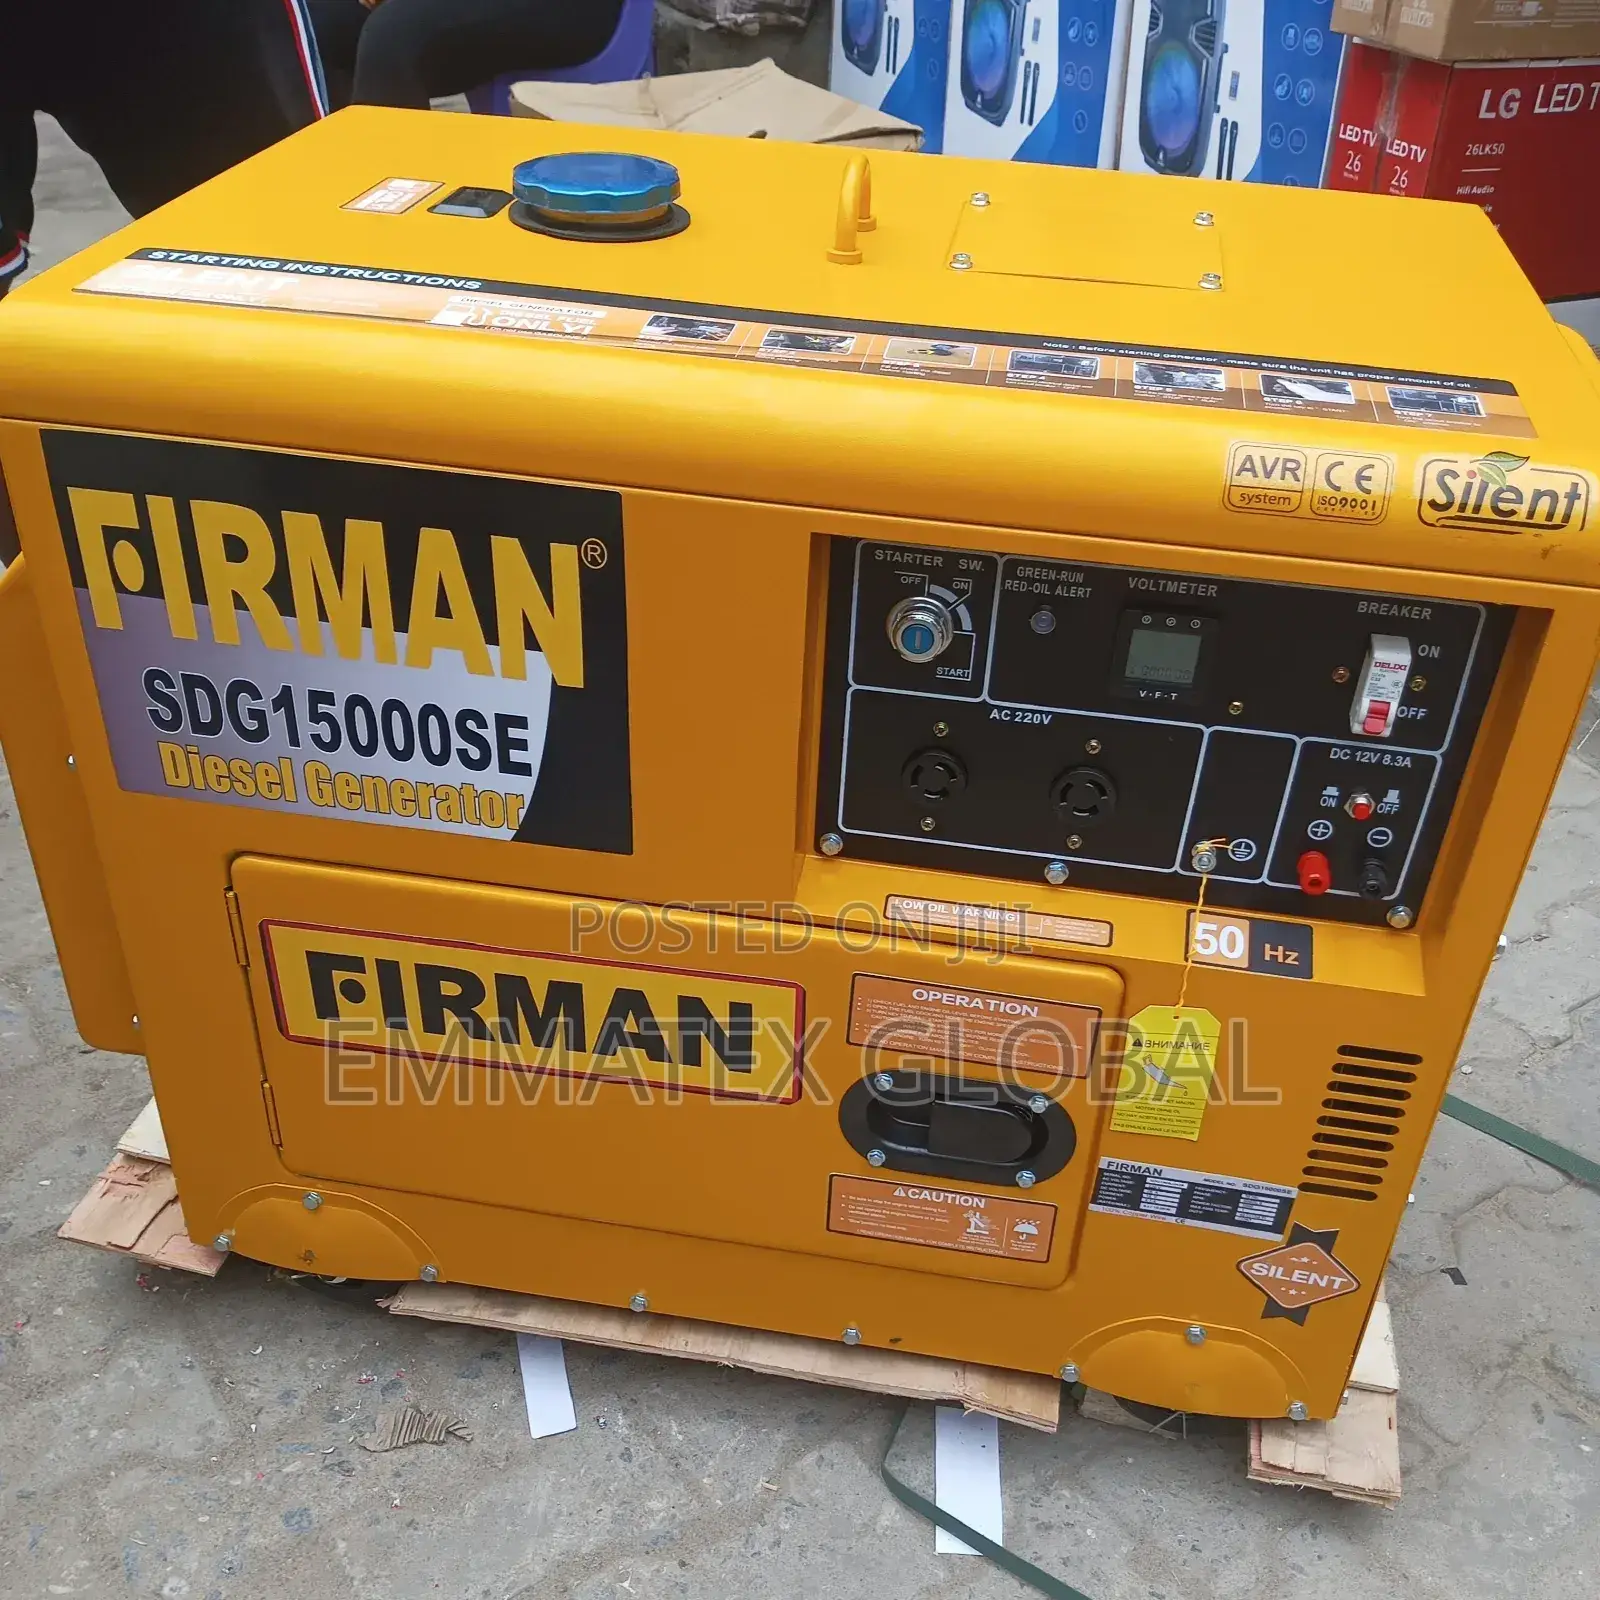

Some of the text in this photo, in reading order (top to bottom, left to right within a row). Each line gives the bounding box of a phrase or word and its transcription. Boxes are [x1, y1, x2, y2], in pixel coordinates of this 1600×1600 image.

[1479, 89, 1521, 119] LG
[1534, 84, 1584, 114] LED
[1339, 123, 1378, 147] LED TV
[1386, 138, 1426, 163] LED TV
[1466, 143, 1504, 156] 26LK50
[1345, 151, 1361, 172] 26
[1391, 166, 1408, 188] 26
[1456, 185, 1494, 195] Hifi Audio
[148, 251, 483, 290] STARTING INSTRUCTIONS
[510, 303, 594, 316] GENERATOR
[494, 316, 597, 336] ONLY!
[1078, 345, 1116, 353] Before
[1119, 349, 1160, 358] starting
[1358, 373, 1395, 381] proper
[1398, 377, 1440, 385] amount
[1393, 410, 1424, 418] STEP
[1235, 454, 1301, 482] AVR
[1324, 460, 1375, 495] CE
[1239, 491, 1291, 506] system
[1318, 496, 1376, 512] ISO9001
[1427, 467, 1582, 524] Silent
[875, 550, 984, 572] STARTER SW.
[901, 576, 921, 585] OFF
[1017, 567, 1084, 583] GREEN-RUN
[67, 486, 584, 688] FIRMAN
[953, 581, 968, 590] ON
[1005, 580, 1092, 598] RED-OIL ALERT
[1129, 577, 1218, 597] VOLTMETER
[1357, 602, 1432, 619] BREAKER
[1418, 645, 1440, 658] ON
[936, 667, 970, 677] START
[141, 667, 532, 777] SDG15000SE
[990, 709, 1052, 725] AC 220V
[1397, 706, 1428, 720] OFF
[1330, 748, 1412, 768] DC 12V 8.3A
[157, 741, 524, 830] Diesel Generator
[1320, 797, 1337, 808] ON
[1377, 803, 1399, 814] OFF
[895, 898, 925, 909] LOW
[928, 903, 948, 914] OIL
[952, 906, 1021, 923] WARNING!
[1194, 921, 1299, 965] 50 Hz
[305, 950, 753, 1074] FIRMAN
[912, 989, 1039, 1017] OPERATION
[1145, 1040, 1210, 1050] ВНИМАНИЕ
[1107, 1161, 1163, 1177] FIRMAN
[908, 1189, 986, 1208] CAUTION
[1150, 1213, 1167, 1221] Wire
[1250, 1262, 1347, 1290] SILENT
